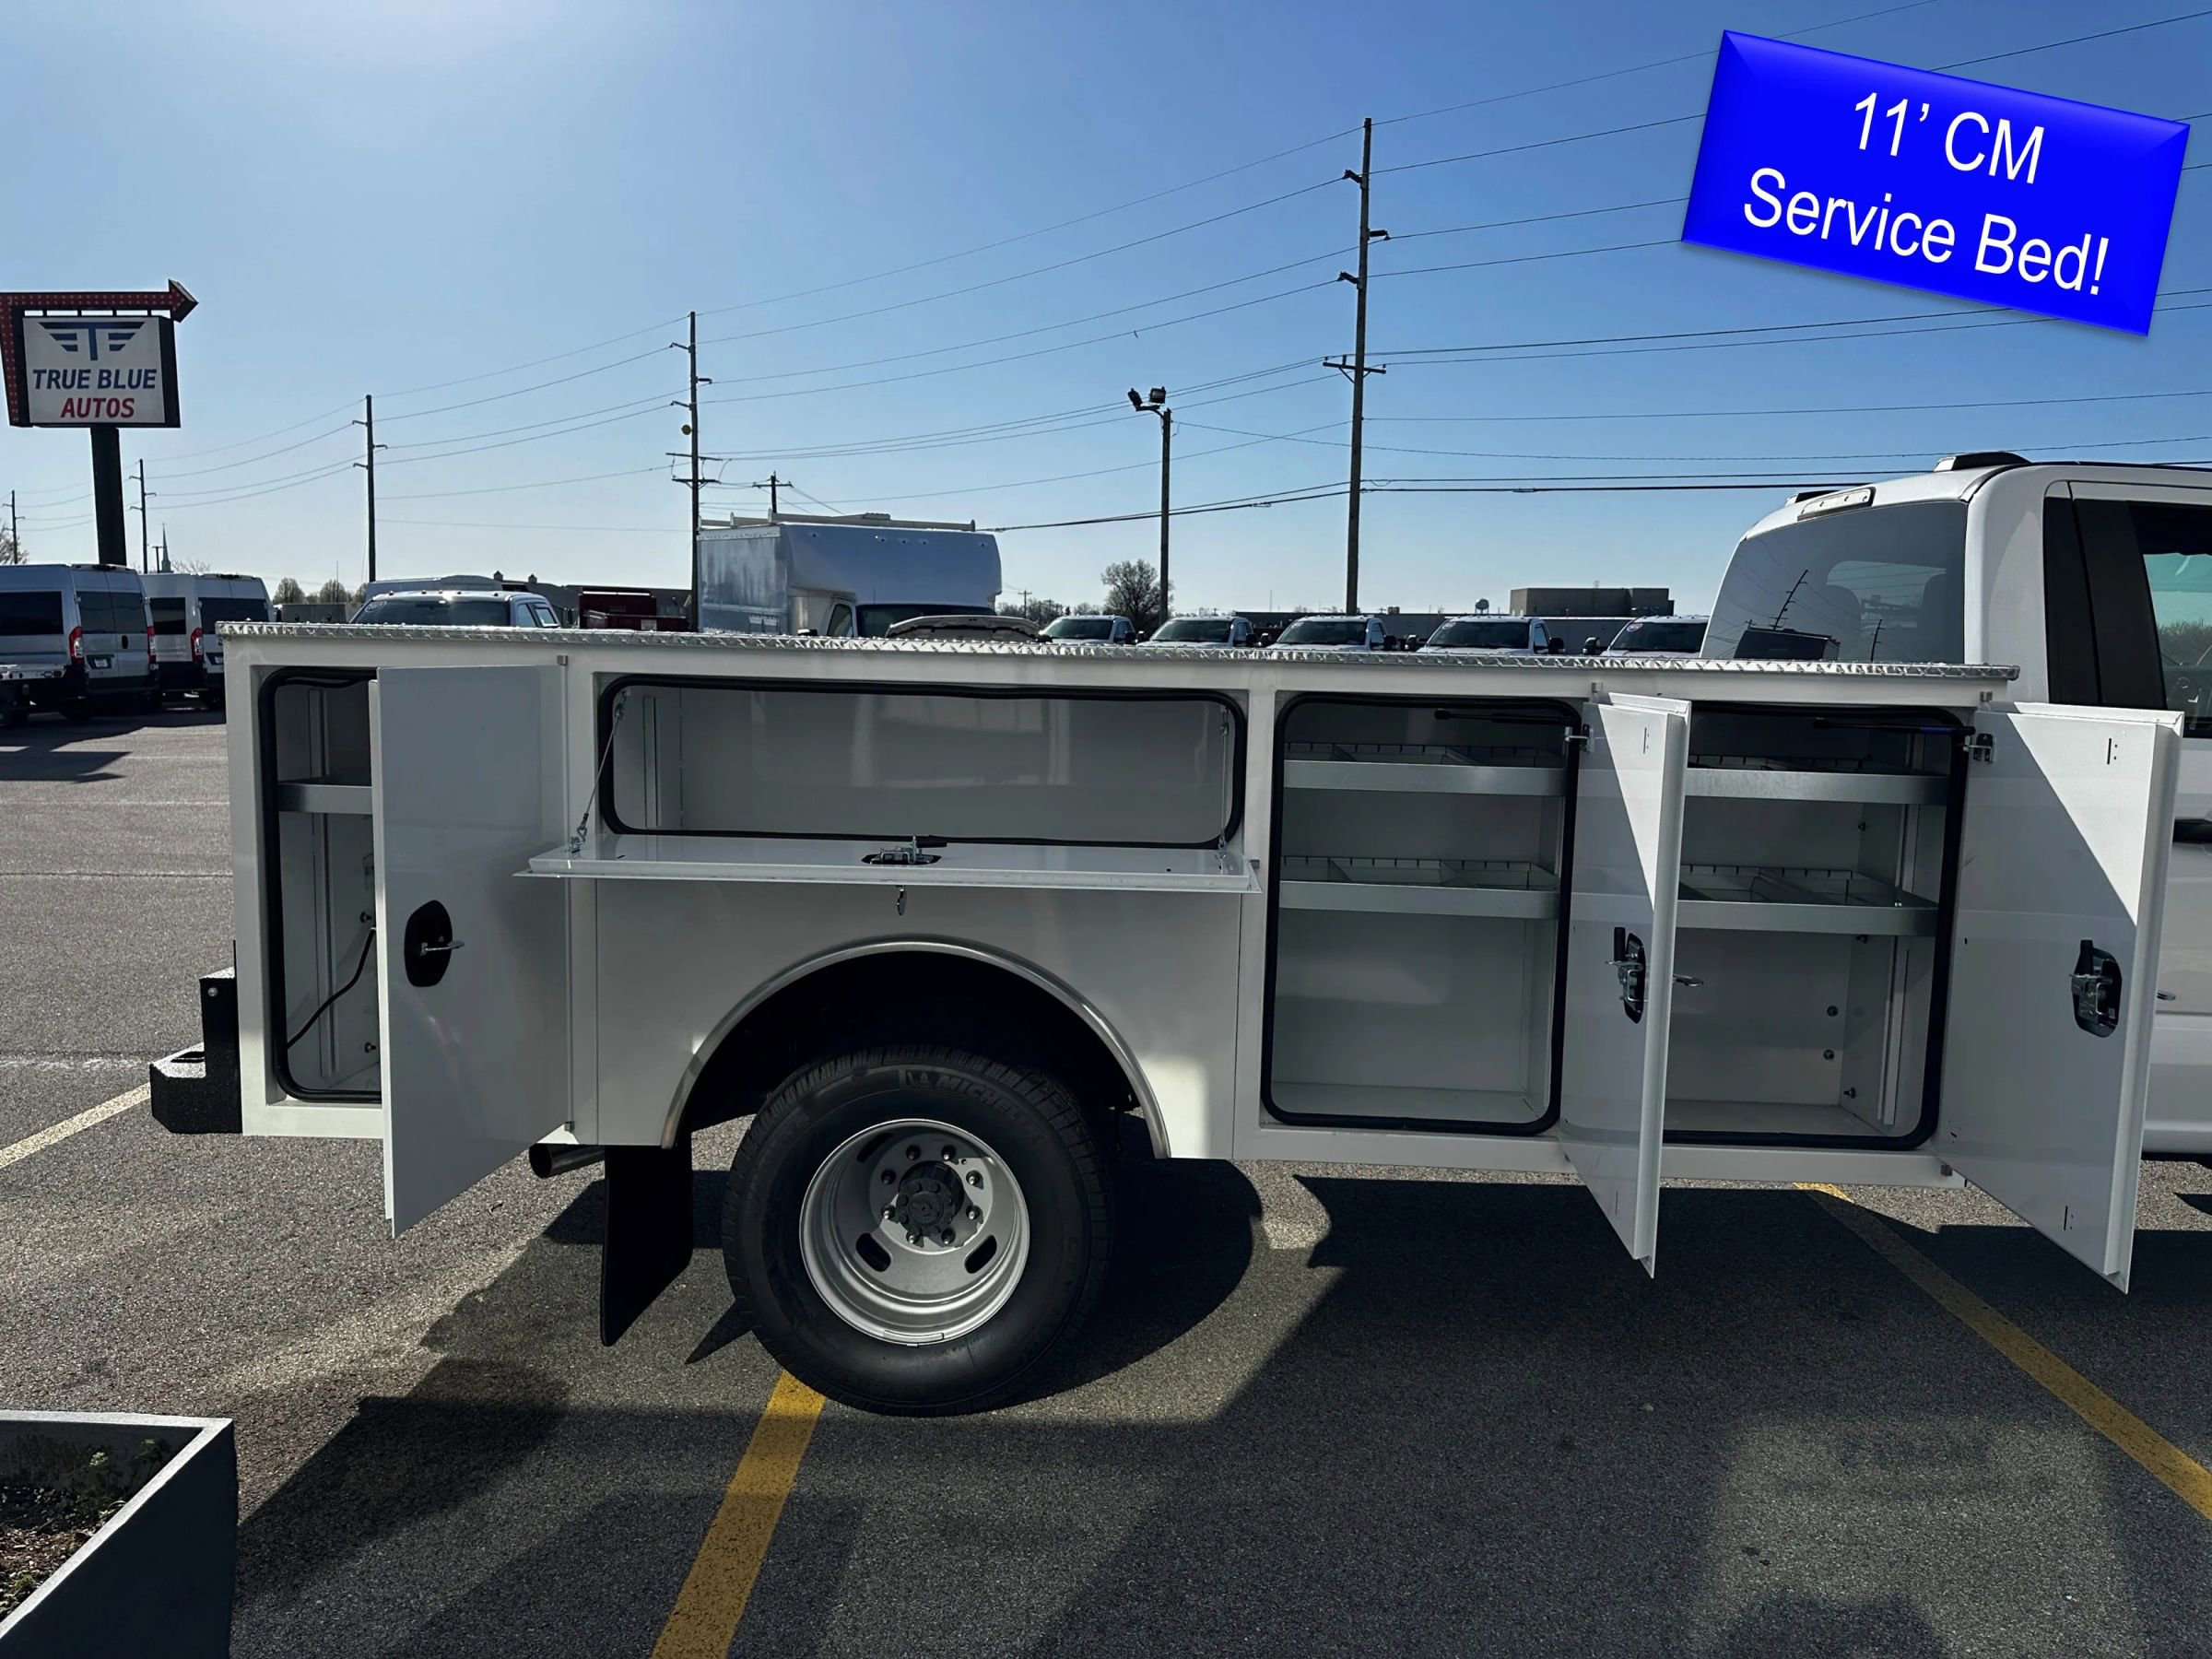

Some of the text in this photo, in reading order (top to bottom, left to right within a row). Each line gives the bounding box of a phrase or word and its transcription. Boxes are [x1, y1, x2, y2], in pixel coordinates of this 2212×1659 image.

[32, 369, 157, 389] TRUE BLUE
[60, 397, 135, 418] AUTOS
